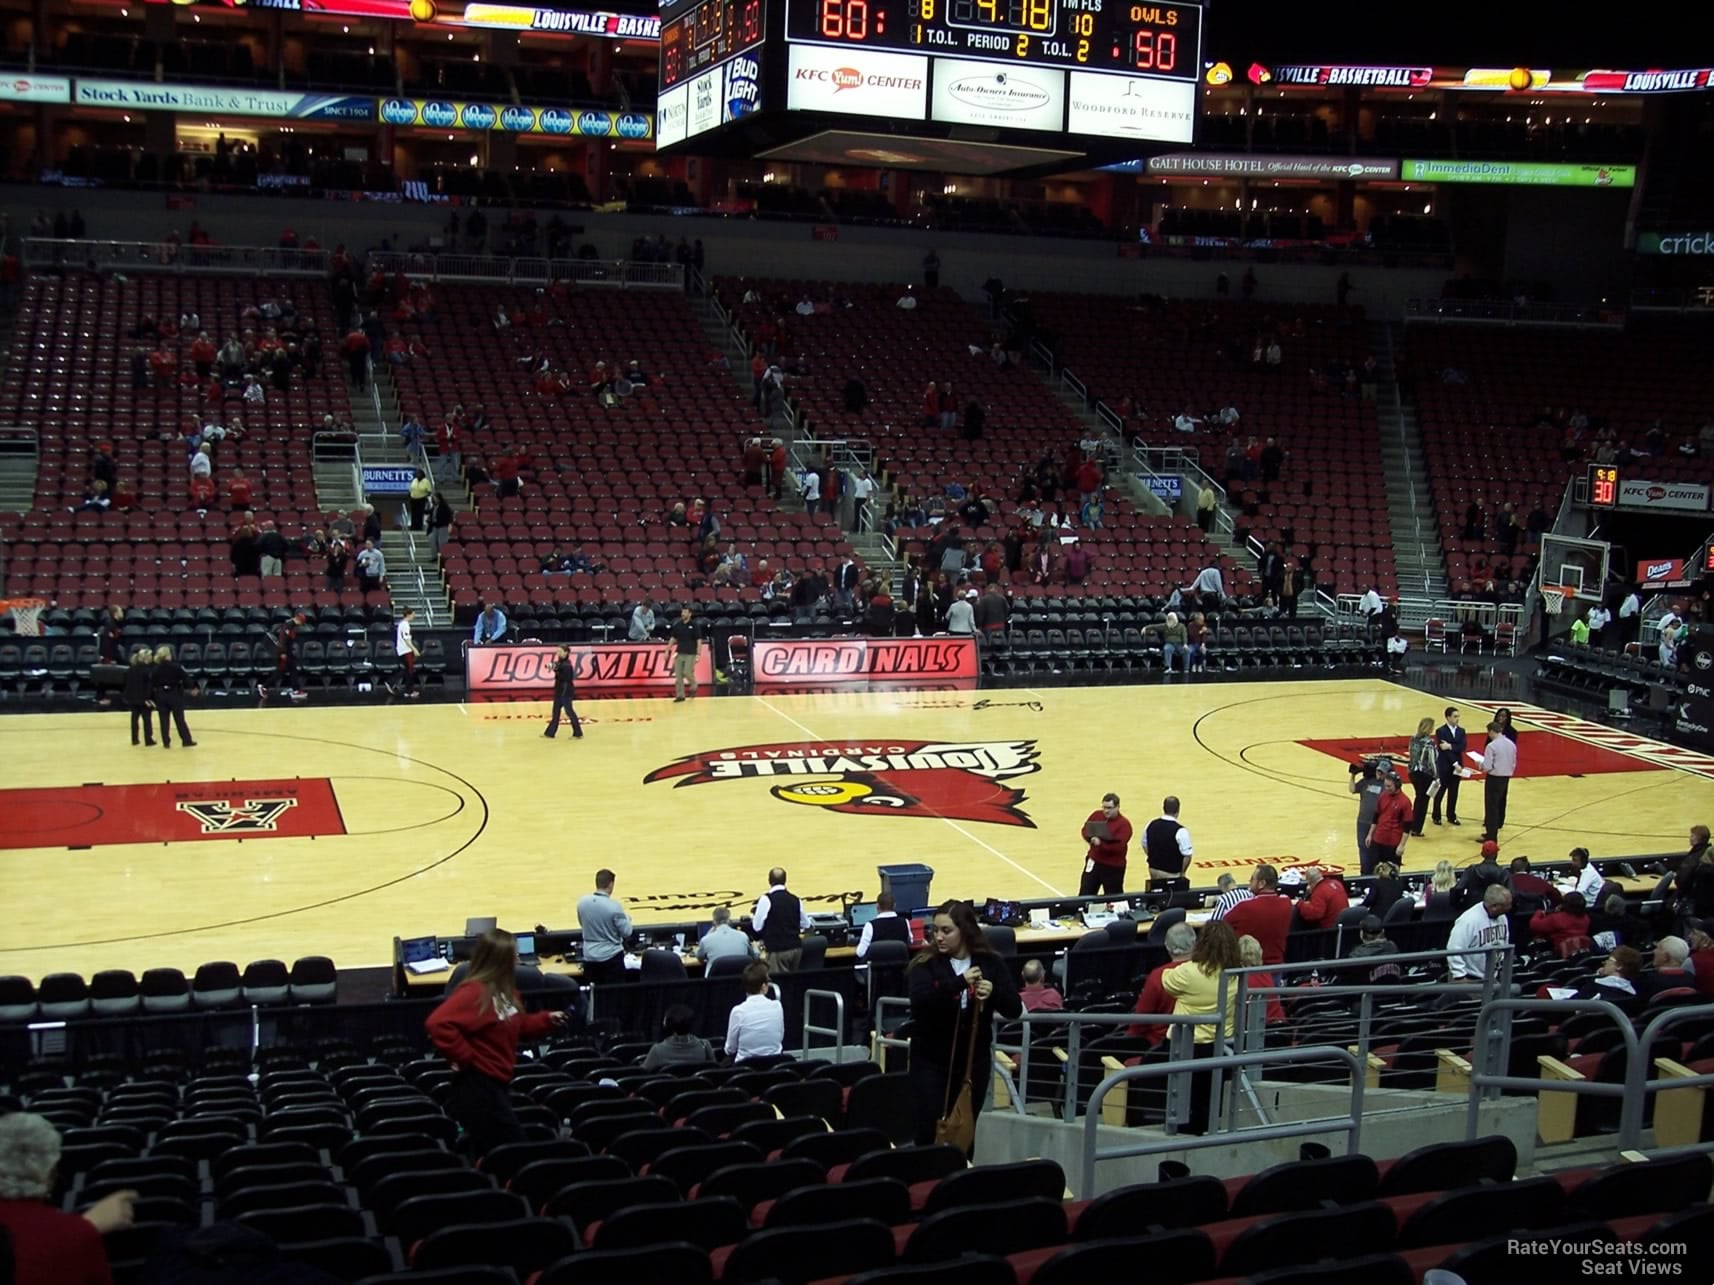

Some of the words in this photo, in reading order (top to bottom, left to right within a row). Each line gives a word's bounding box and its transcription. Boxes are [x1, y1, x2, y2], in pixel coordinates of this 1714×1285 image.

[533, 11, 608, 32] LOUISVILLE
[823, 0, 867, 39] 60
[1075, 14, 1093, 36] 10
[1131, 6, 1178, 25] OWLS
[927, 29, 958, 45] T.O.L.
[968, 33, 1010, 50] PERIOD
[1016, 34, 1029, 57] 2
[1042, 41, 1072, 57] T.O.L.
[1077, 40, 1089, 62] 2
[1136, 31, 1176, 70] 50
[732, 57, 758, 80] BUD
[1328, 68, 1411, 86] BASKETBALL
[796, 68, 829, 82] KFC
[834, 71, 863, 85] Yum!
[867, 74, 922, 91] CENTER
[1624, 71, 1698, 91] LOUISVILLE
[82, 87, 129, 102] Stock
[132, 90, 179, 105] Yards
[182, 92, 224, 109] Bank
[228, 96, 240, 110] &
[244, 96, 289, 112] Trust
[323, 106, 347, 116] SINCE
[349, 108, 369, 117] 1904
[385, 102, 417, 121] Kroger
[425, 104, 456, 124] Kroger
[464, 105, 496, 125] Kroger
[503, 108, 534, 127] Kroger
[542, 110, 573, 130] Kroger
[1072, 100, 1136, 116] WOODFORD
[1141, 107, 1191, 121] RESERVE
[580, 112, 611, 132] Kroger
[618, 115, 648, 135] Kroger
[1150, 158, 1180, 170] GALT
[1182, 159, 1222, 171] HOUSE
[1225, 160, 1264, 172] HOTEL
[1598, 469, 1616, 481] 9:18
[1594, 481, 1613, 502] 30
[1623, 487, 1644, 496] KFC
[1668, 490, 1705, 500] CENTER
[762, 644, 968, 676] CARDINALS
[1695, 686, 1711, 697] PNC
[709, 742, 1035, 778] LOUISVILLE
[719, 746, 905, 760] CARDINALS
[1195, 855, 1300, 869] CENTER
